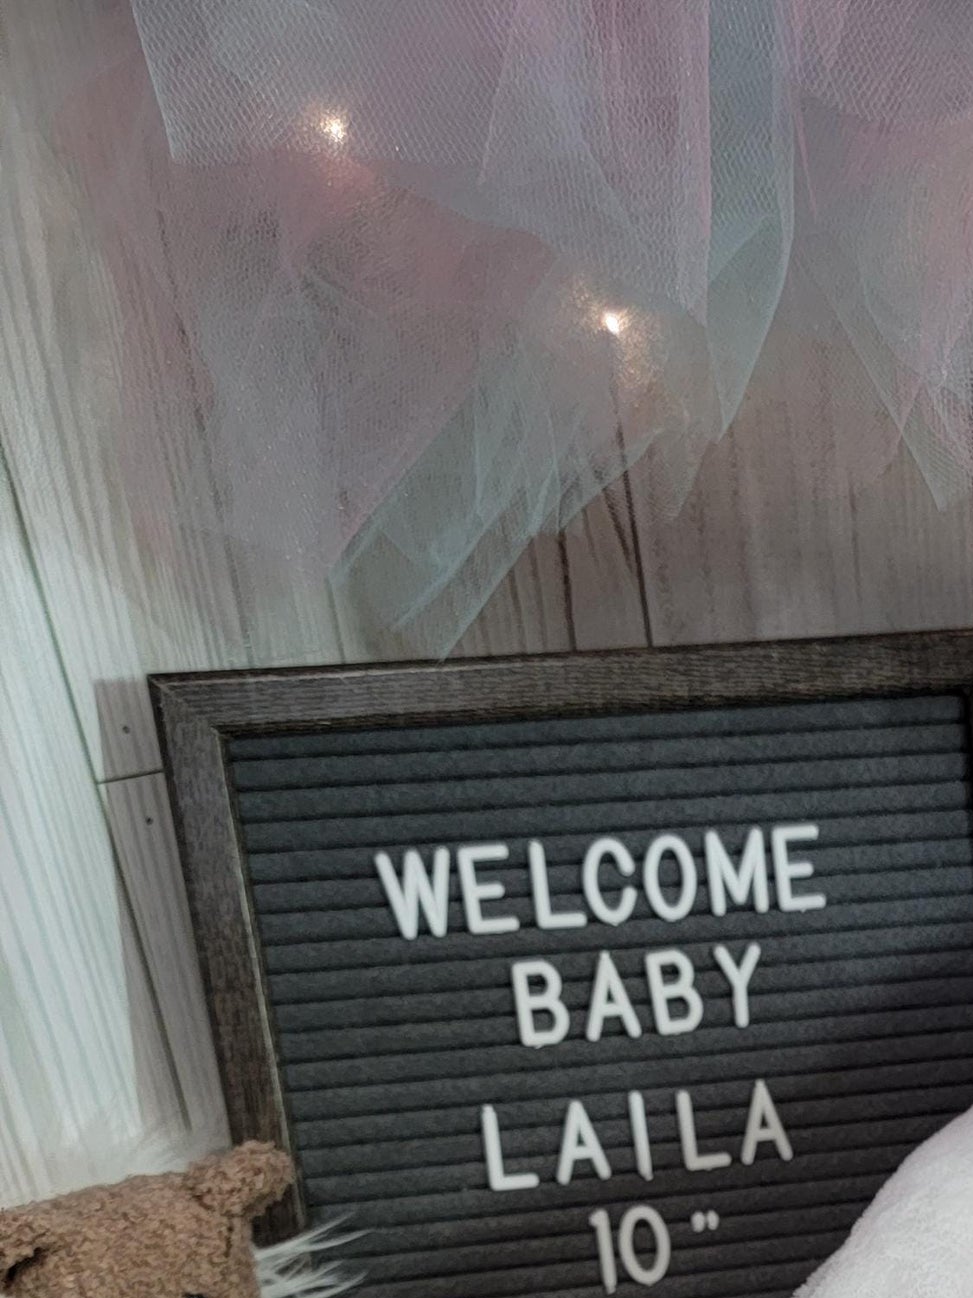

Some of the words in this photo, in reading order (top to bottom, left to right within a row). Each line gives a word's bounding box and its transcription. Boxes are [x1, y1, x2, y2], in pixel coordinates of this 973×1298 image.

[374, 824, 827, 940] WELCOME
[513, 943, 762, 1047] BABY
[482, 1079, 794, 1191] LAILA
